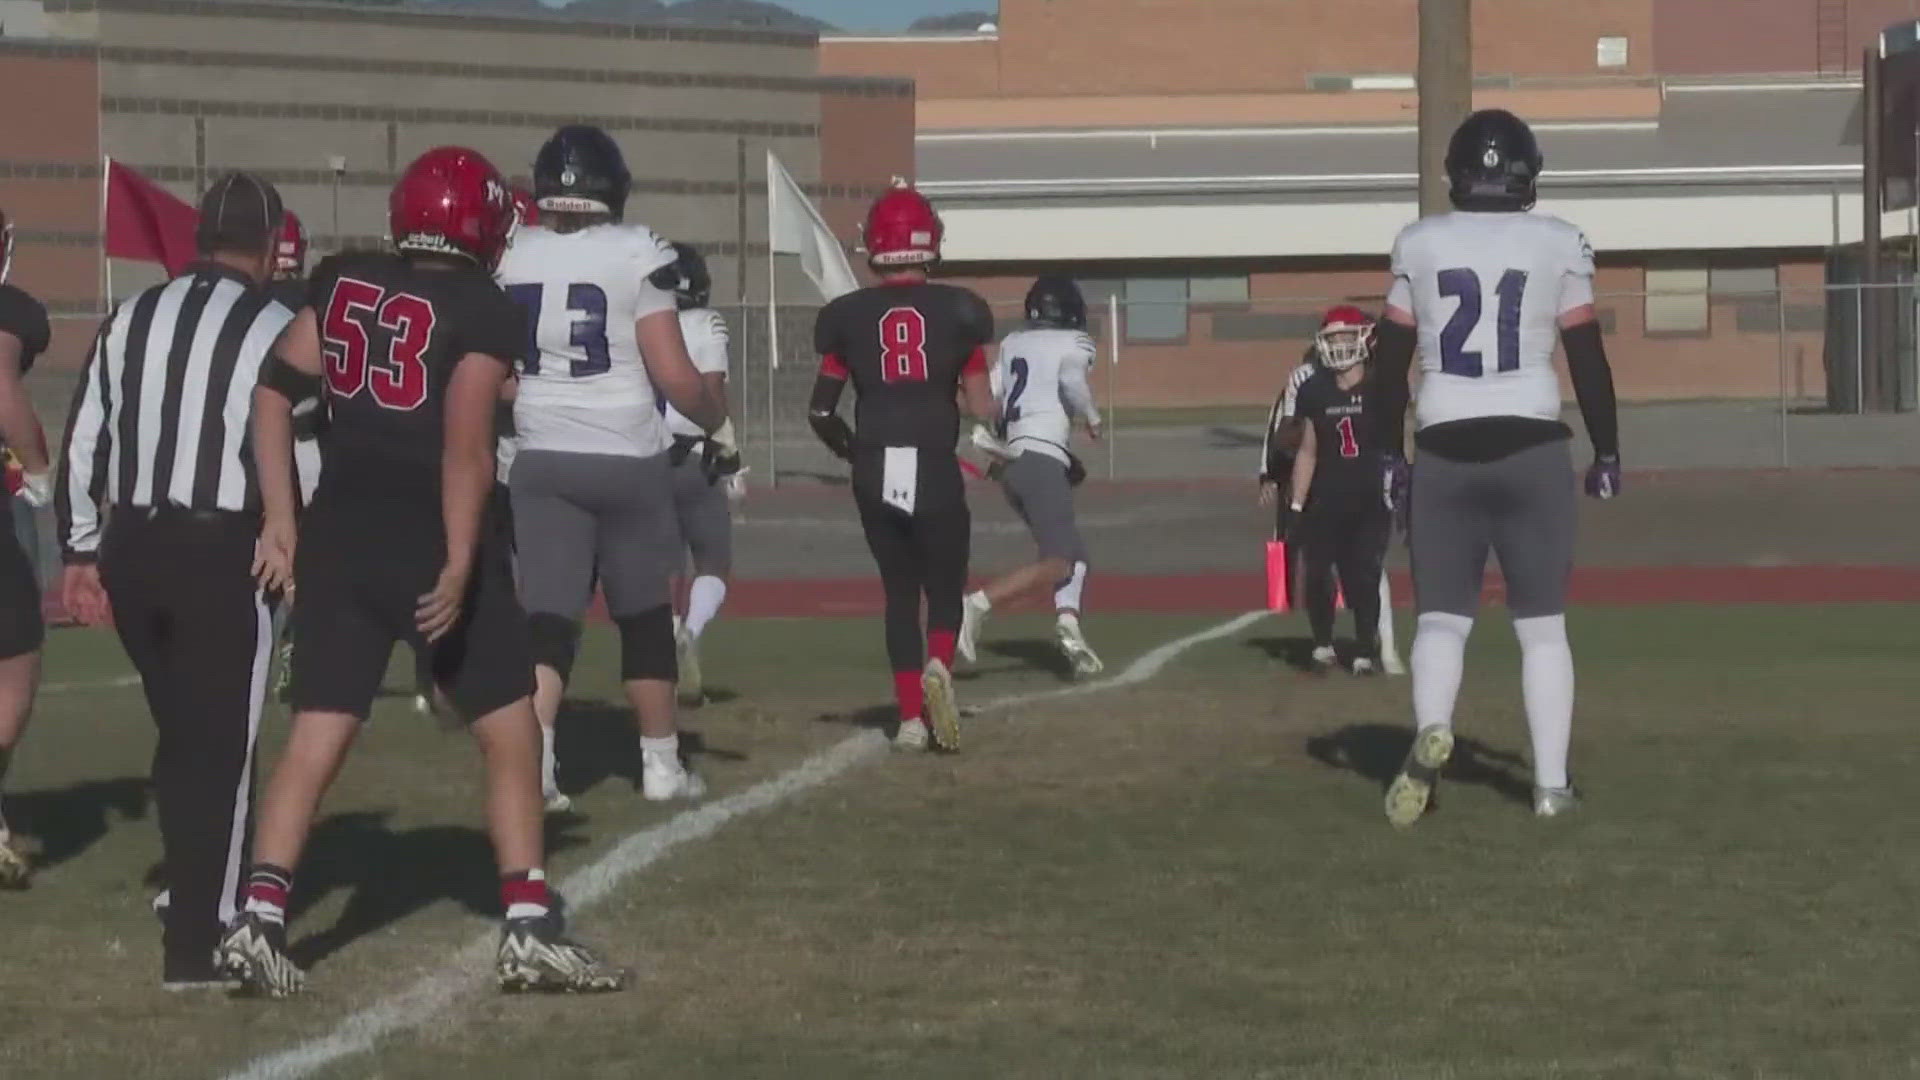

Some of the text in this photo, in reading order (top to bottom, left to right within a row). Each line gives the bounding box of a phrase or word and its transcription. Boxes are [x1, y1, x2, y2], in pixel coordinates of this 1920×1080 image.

[323, 277, 436, 410] 53
[879, 306, 928, 383] 8
[1438, 267, 1529, 378] 21
[1006, 356, 1029, 421] 2
[1336, 416, 1359, 457] 1
